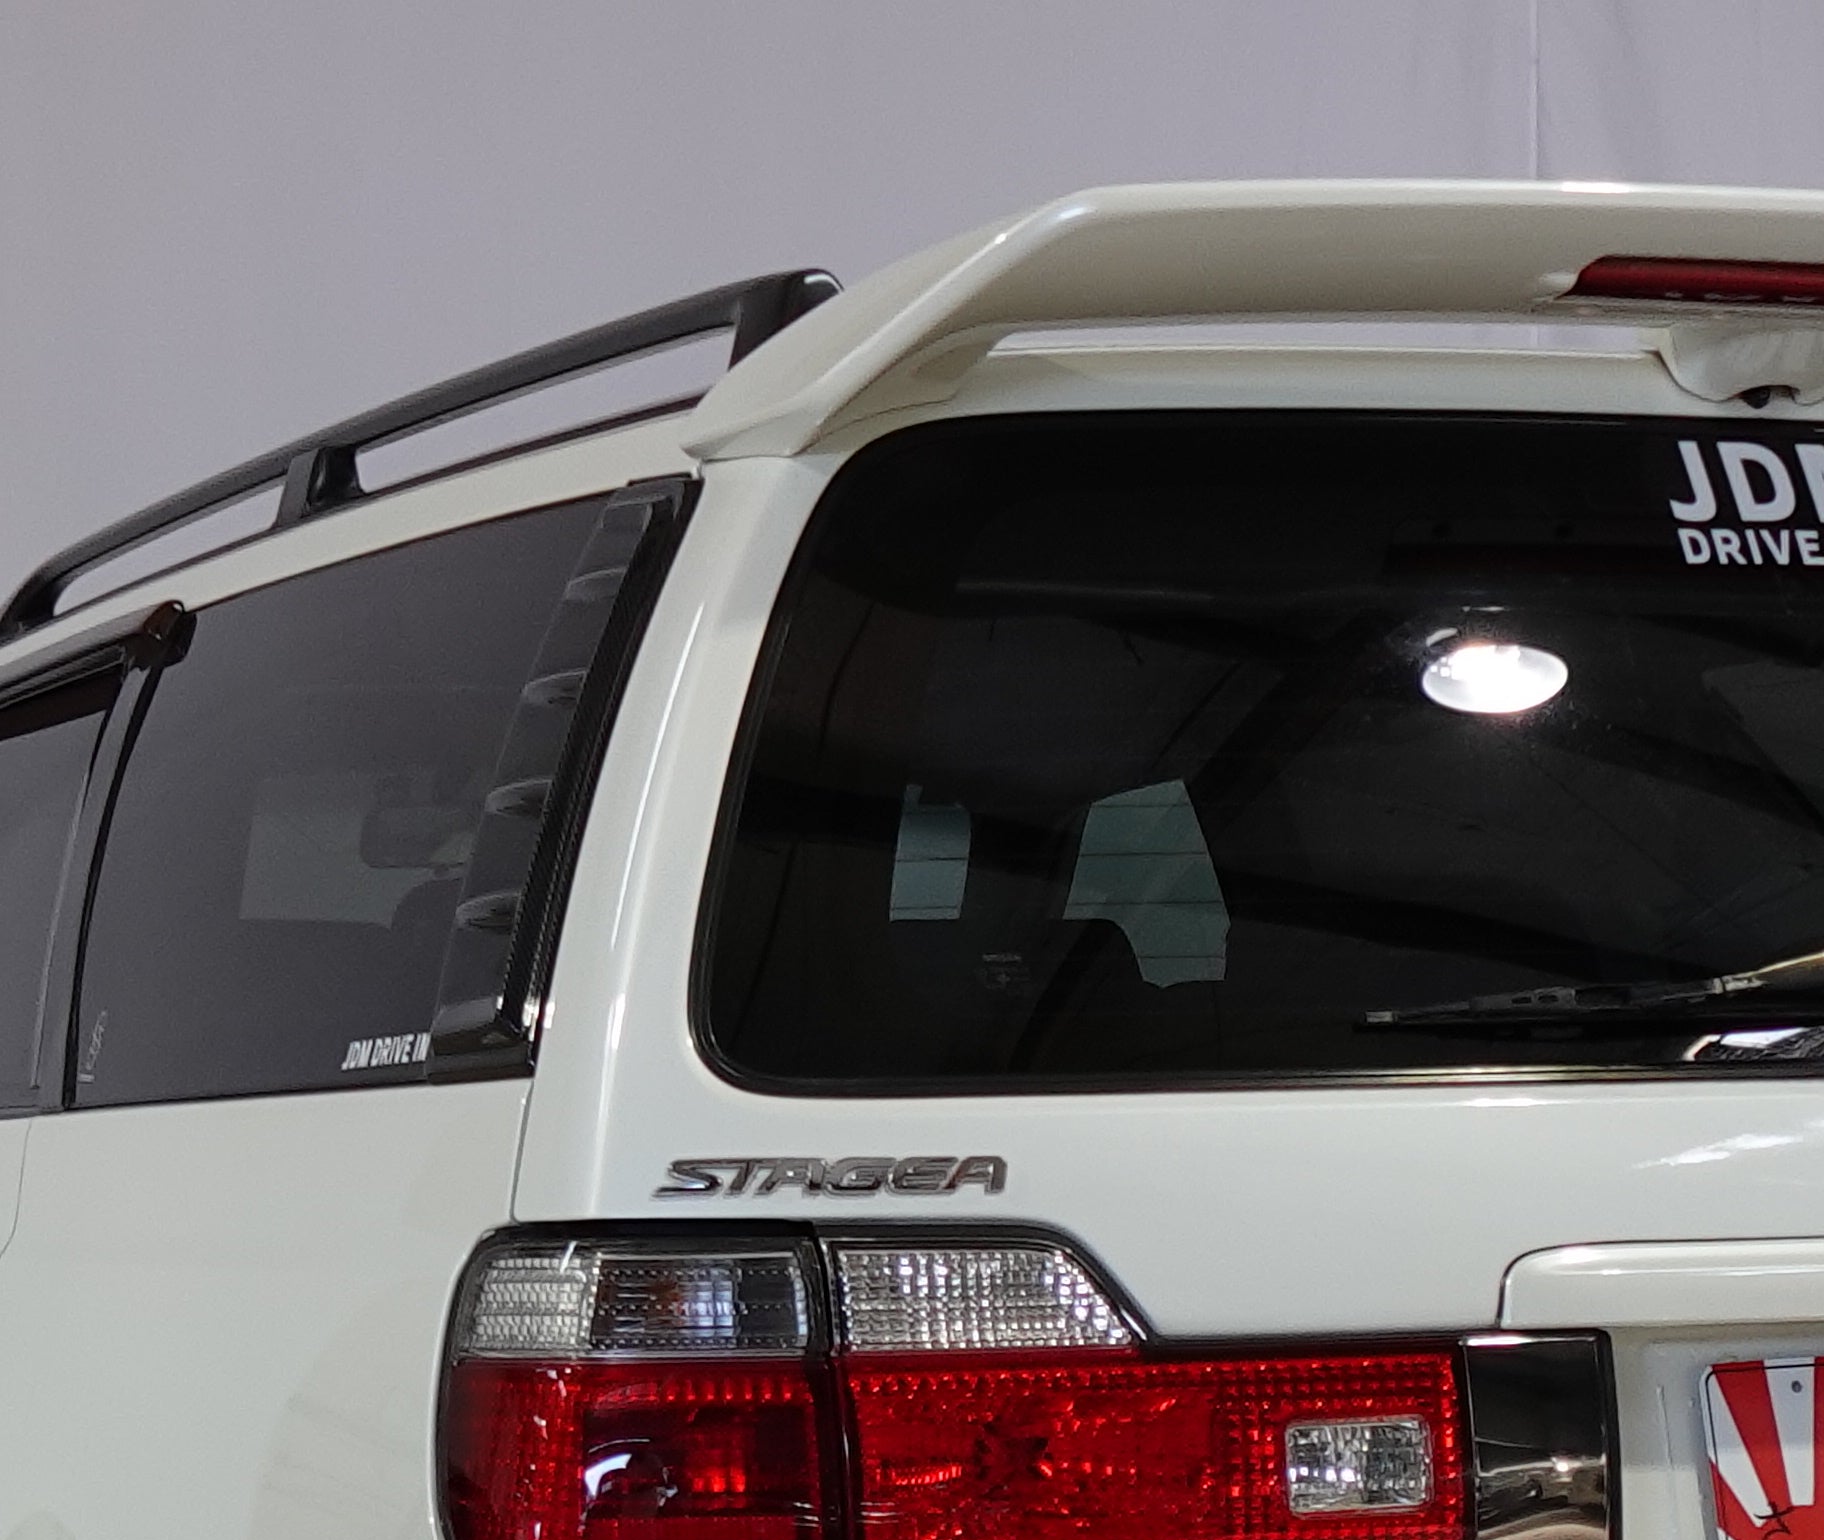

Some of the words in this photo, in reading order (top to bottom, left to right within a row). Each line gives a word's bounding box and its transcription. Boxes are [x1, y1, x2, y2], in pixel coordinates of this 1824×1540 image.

[341, 1039, 374, 1071] JDM
[370, 1033, 415, 1068] DRIVE
[651, 1155, 1009, 1200] STAGEA
